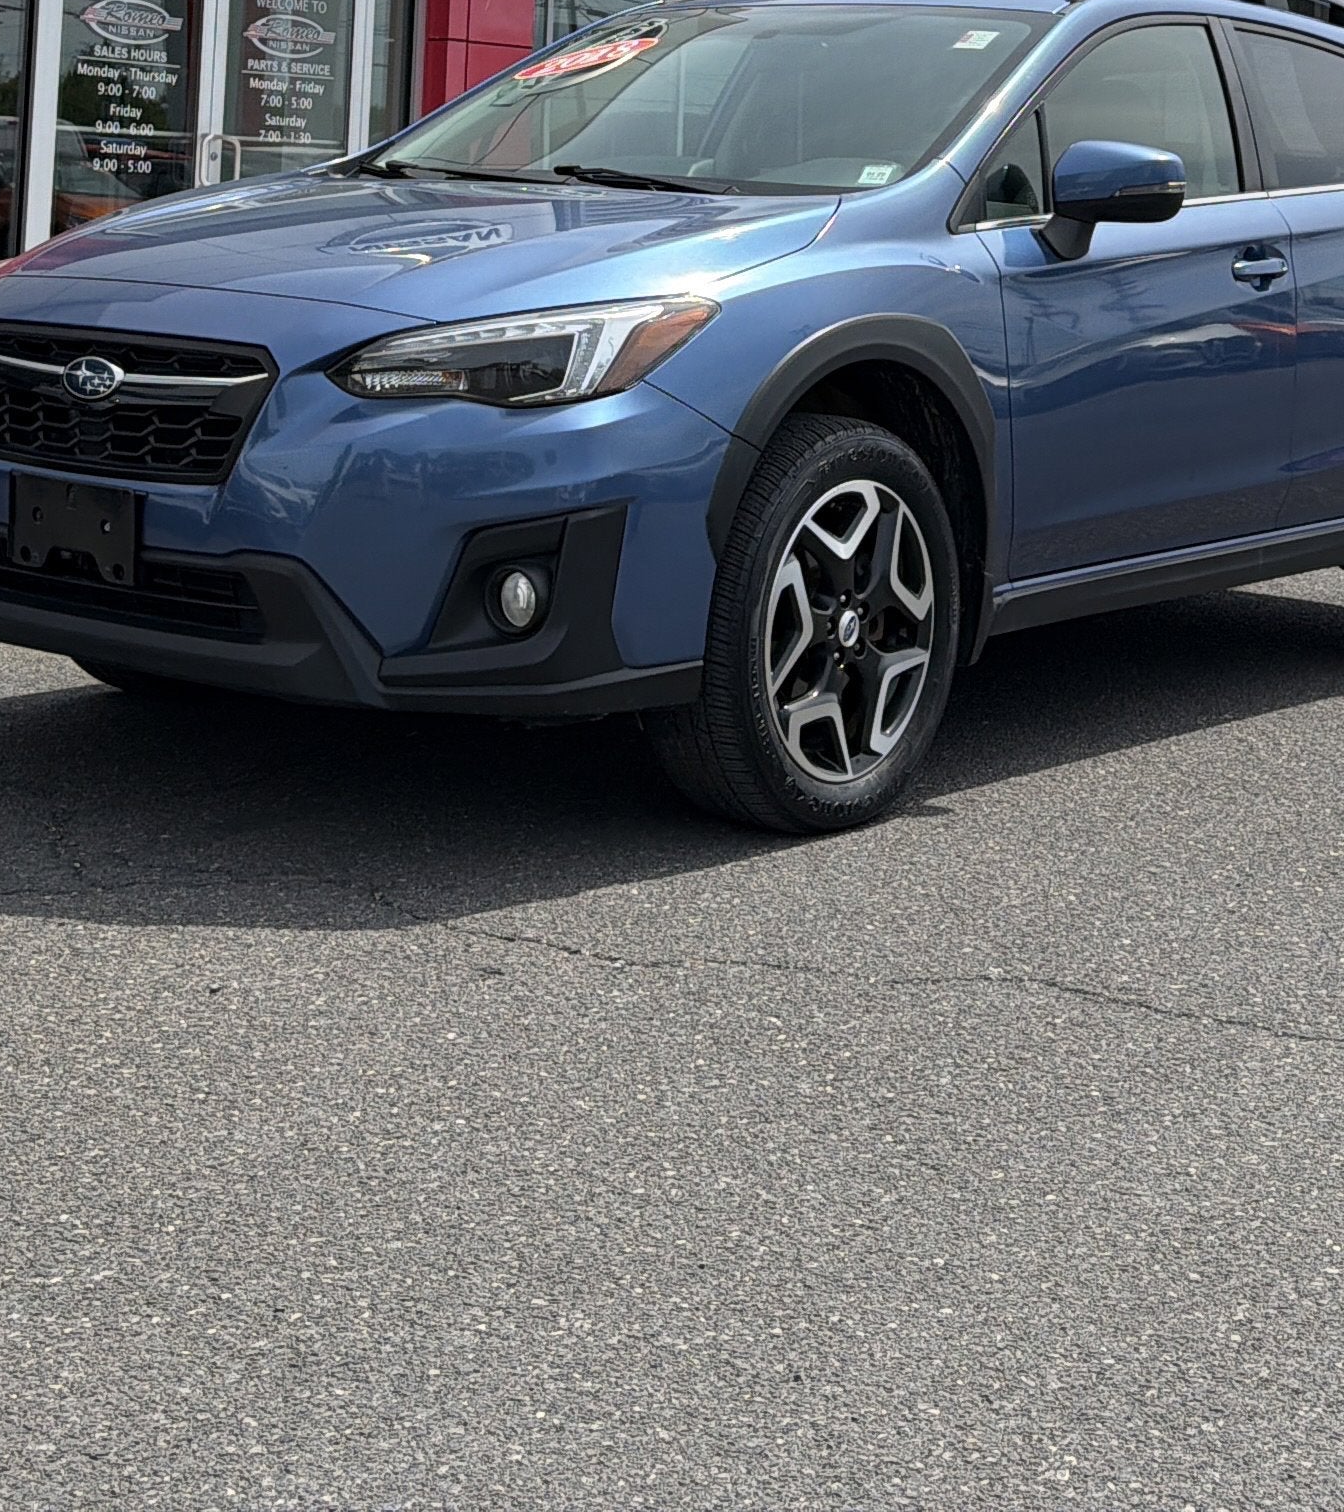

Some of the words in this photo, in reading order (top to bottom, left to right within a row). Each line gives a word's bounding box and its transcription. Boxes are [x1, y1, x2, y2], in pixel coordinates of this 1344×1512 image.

[101, 1, 166, 26] Romeo
[312, 0, 328, 14] TO
[108, 25, 155, 38] NISSAN
[260, 18, 322, 41] Romeo
[94, 44, 128, 59] SALES
[130, 48, 168, 63] HOURS
[267, 40, 310, 52] NISSAN
[77, 62, 121, 81] Monday
[129, 67, 178, 86] Thursday
[247, 58, 279, 73] PARTS
[280, 62, 289, 73] &
[290, 63, 331, 76] SERVICE
[97, 82, 123, 97] 9:00
[132, 85, 157, 100] 7:00
[249, 77, 289, 93] Monday
[295, 80, 325, 96] Friday
[260, 94, 283, 108] 7:00
[291, 96, 313, 110] 5:00
[109, 103, 143, 120] Friday
[95, 120, 121, 134] 9:00
[129, 122, 155, 136] 6:00
[264, 113, 307, 129] Saturday
[258, 129, 281, 142] 7:00
[290, 131, 312, 144] 1:30
[99, 140, 148, 158] Saturday
[92, 157, 118, 172] 9:00
[127, 159, 152, 174] 5:00
